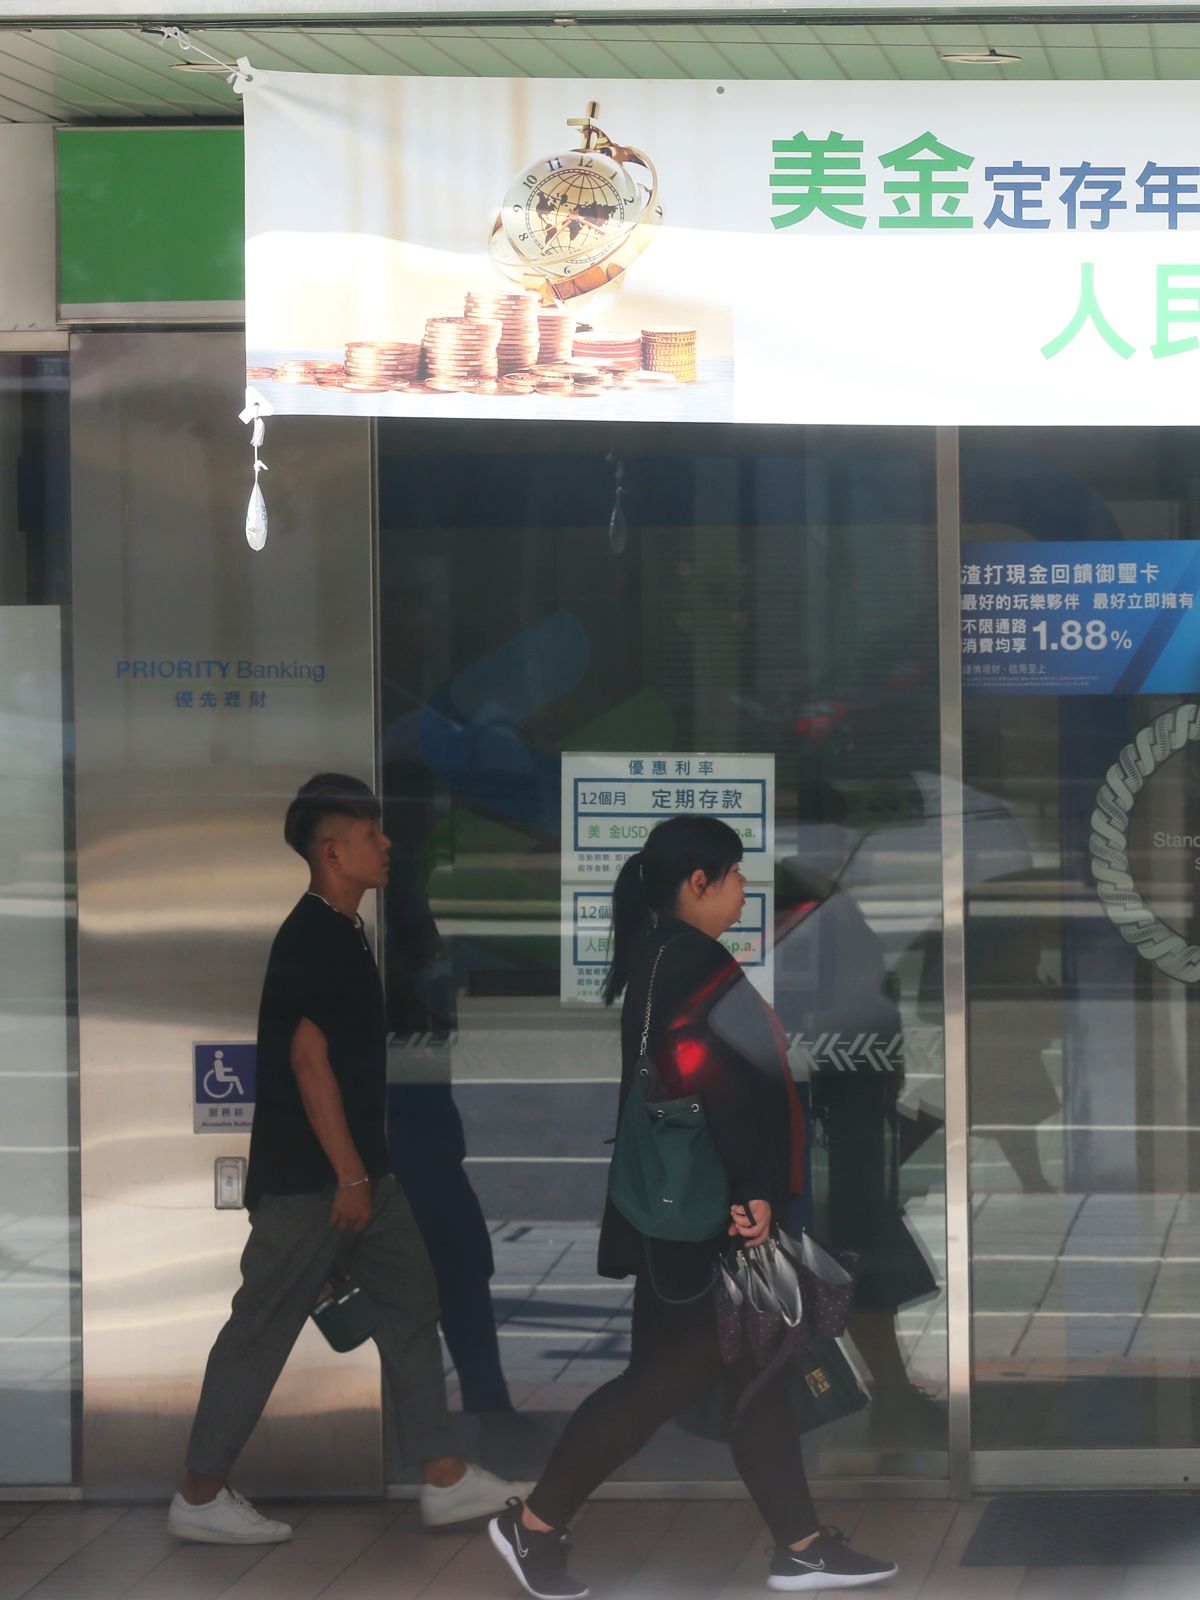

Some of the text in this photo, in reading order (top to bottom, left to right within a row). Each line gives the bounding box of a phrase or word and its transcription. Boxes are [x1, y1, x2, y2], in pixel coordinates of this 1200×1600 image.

[961, 562, 1160, 585] 渣打現金回饋御璽卡
[961, 592, 1194, 610] 最好的玩樂夥伴 最好立即擁有
[962, 618, 1027, 635] 不限通路
[1032, 619, 1132, 651] 1.88%
[962, 637, 1027, 653] 消費均享
[116, 660, 326, 683] PRIORITY Banking
[176, 690, 267, 708] 優先理財
[629, 759, 715, 776] 優惠利率
[580, 788, 742, 809] 12個月 定期存款
